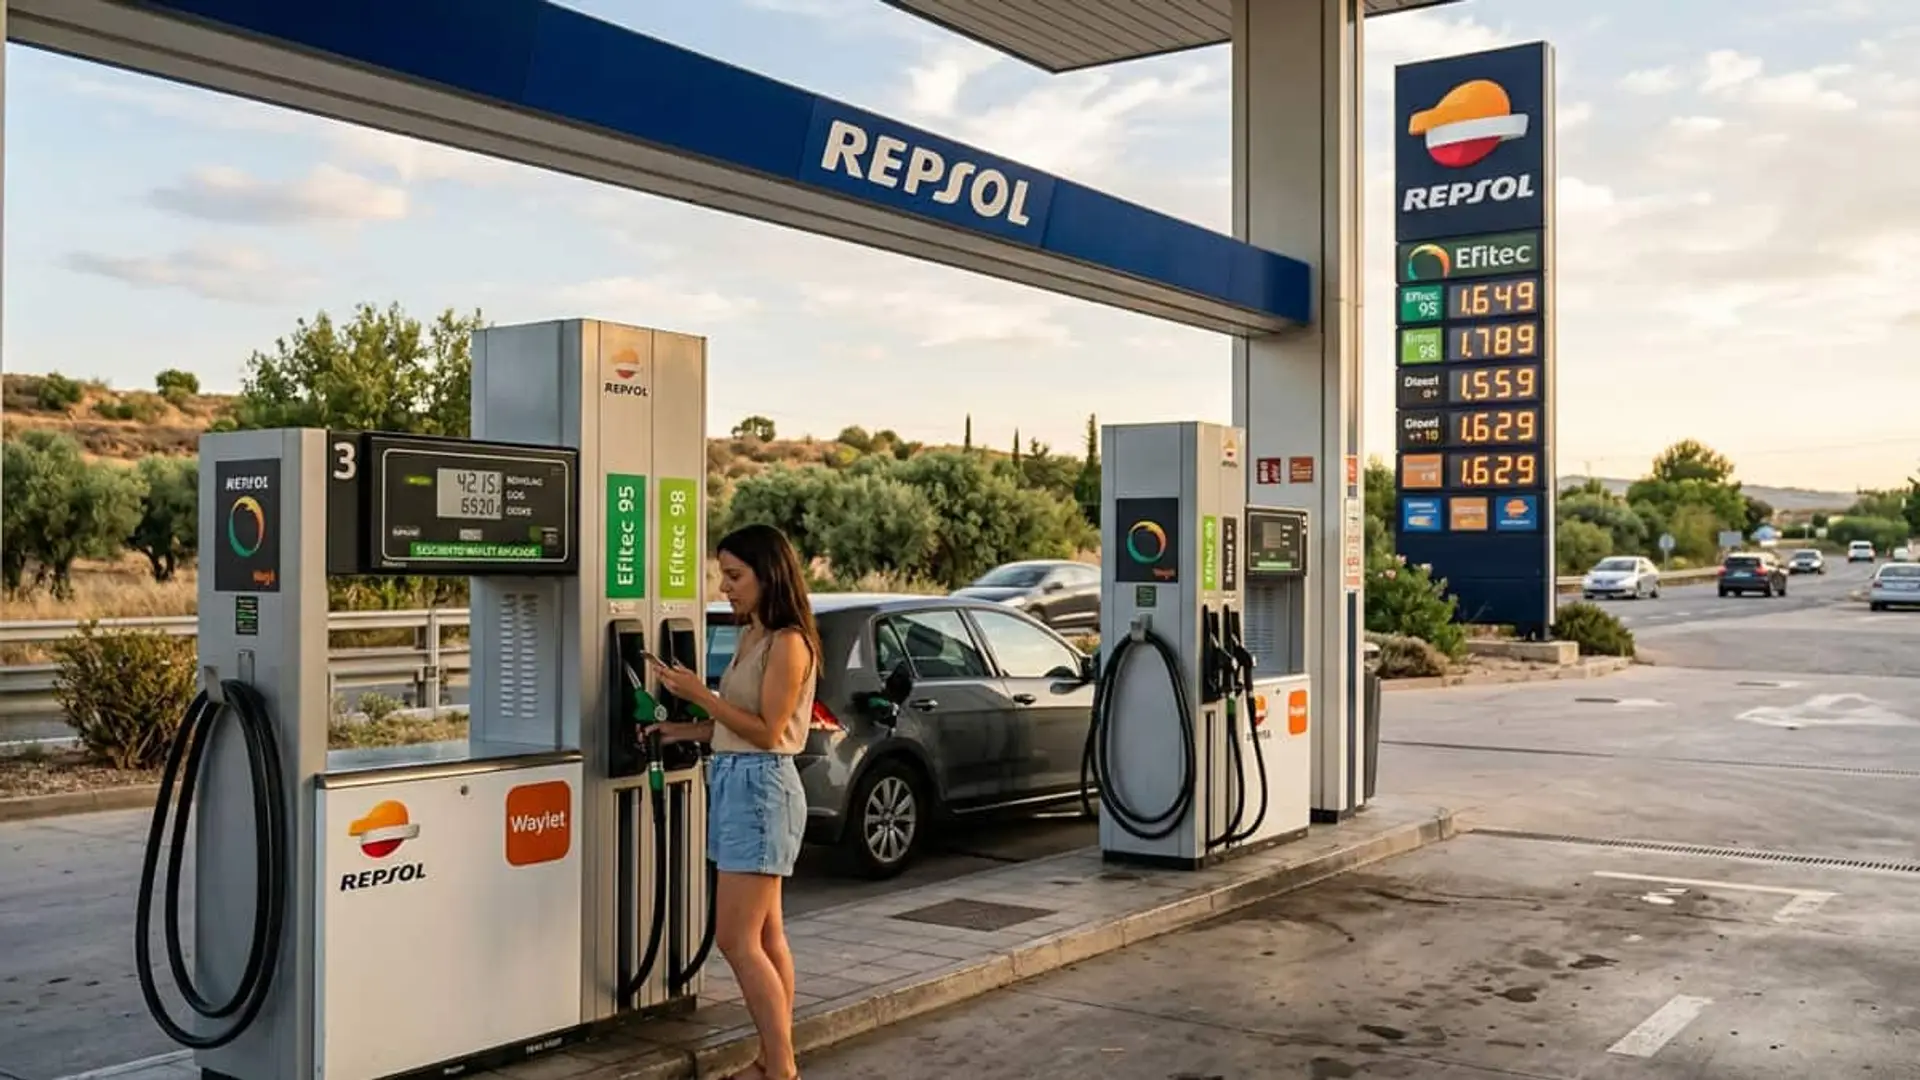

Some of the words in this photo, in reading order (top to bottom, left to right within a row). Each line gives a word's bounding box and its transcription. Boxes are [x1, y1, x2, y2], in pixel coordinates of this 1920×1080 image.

[820, 119, 1030, 228] REPSOL
[1403, 173, 1535, 212] REPSOL
[1456, 245, 1532, 269] Efitec
[1460, 281, 1536, 315] 1.649
[1460, 324, 1536, 358] 1.789
[1460, 368, 1536, 400] 1.559
[1460, 411, 1536, 443] 1.629
[333, 442, 357, 480] 3
[1460, 455, 1536, 486] 1.629
[617, 485, 635, 512] 95
[670, 490, 686, 516] 98
[617, 522, 635, 586] Efitec
[670, 525, 686, 587] Efitec
[511, 811, 566, 835] Waylet
[340, 864, 426, 891] REPSOL
